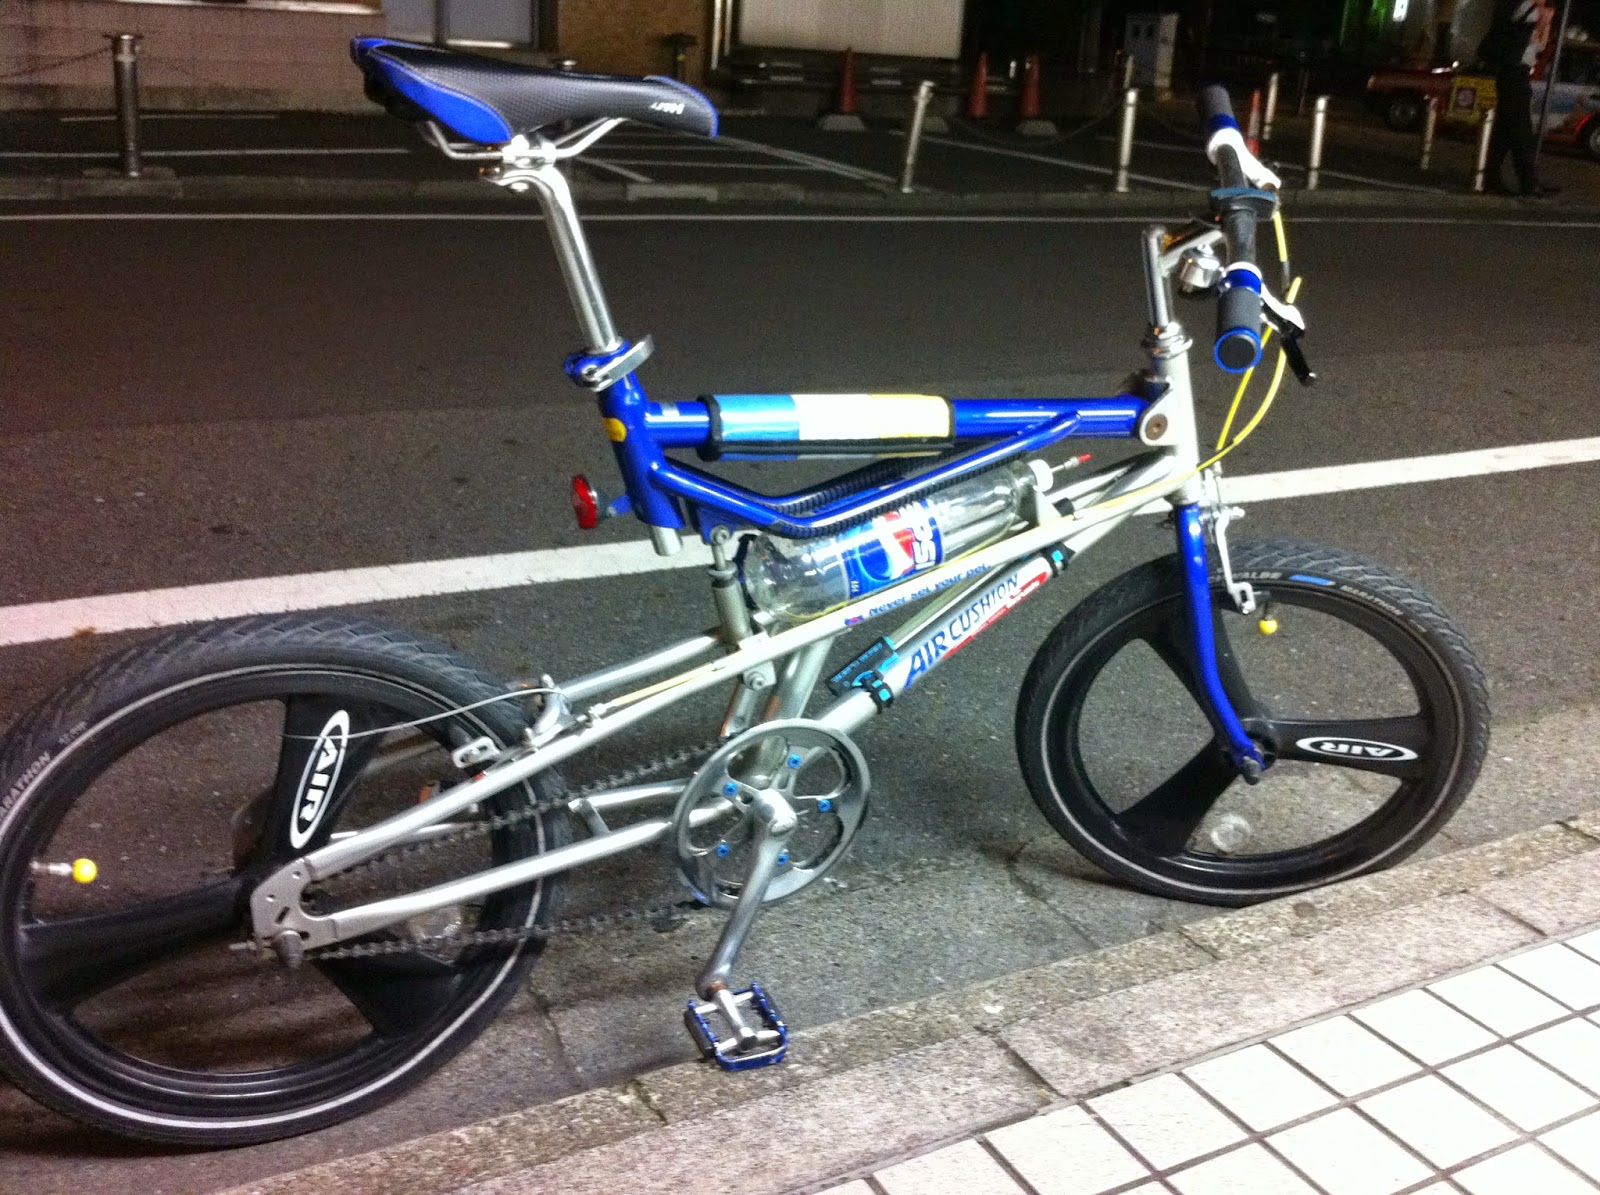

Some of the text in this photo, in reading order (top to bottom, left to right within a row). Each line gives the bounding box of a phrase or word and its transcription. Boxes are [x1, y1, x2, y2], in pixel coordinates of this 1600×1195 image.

[904, 631, 949, 691] AIR
[948, 573, 1019, 641] CUSHION
[0, 751, 51, 818] ARATHON
[299, 737, 339, 823] AIR
[1319, 741, 1395, 757] AIR
